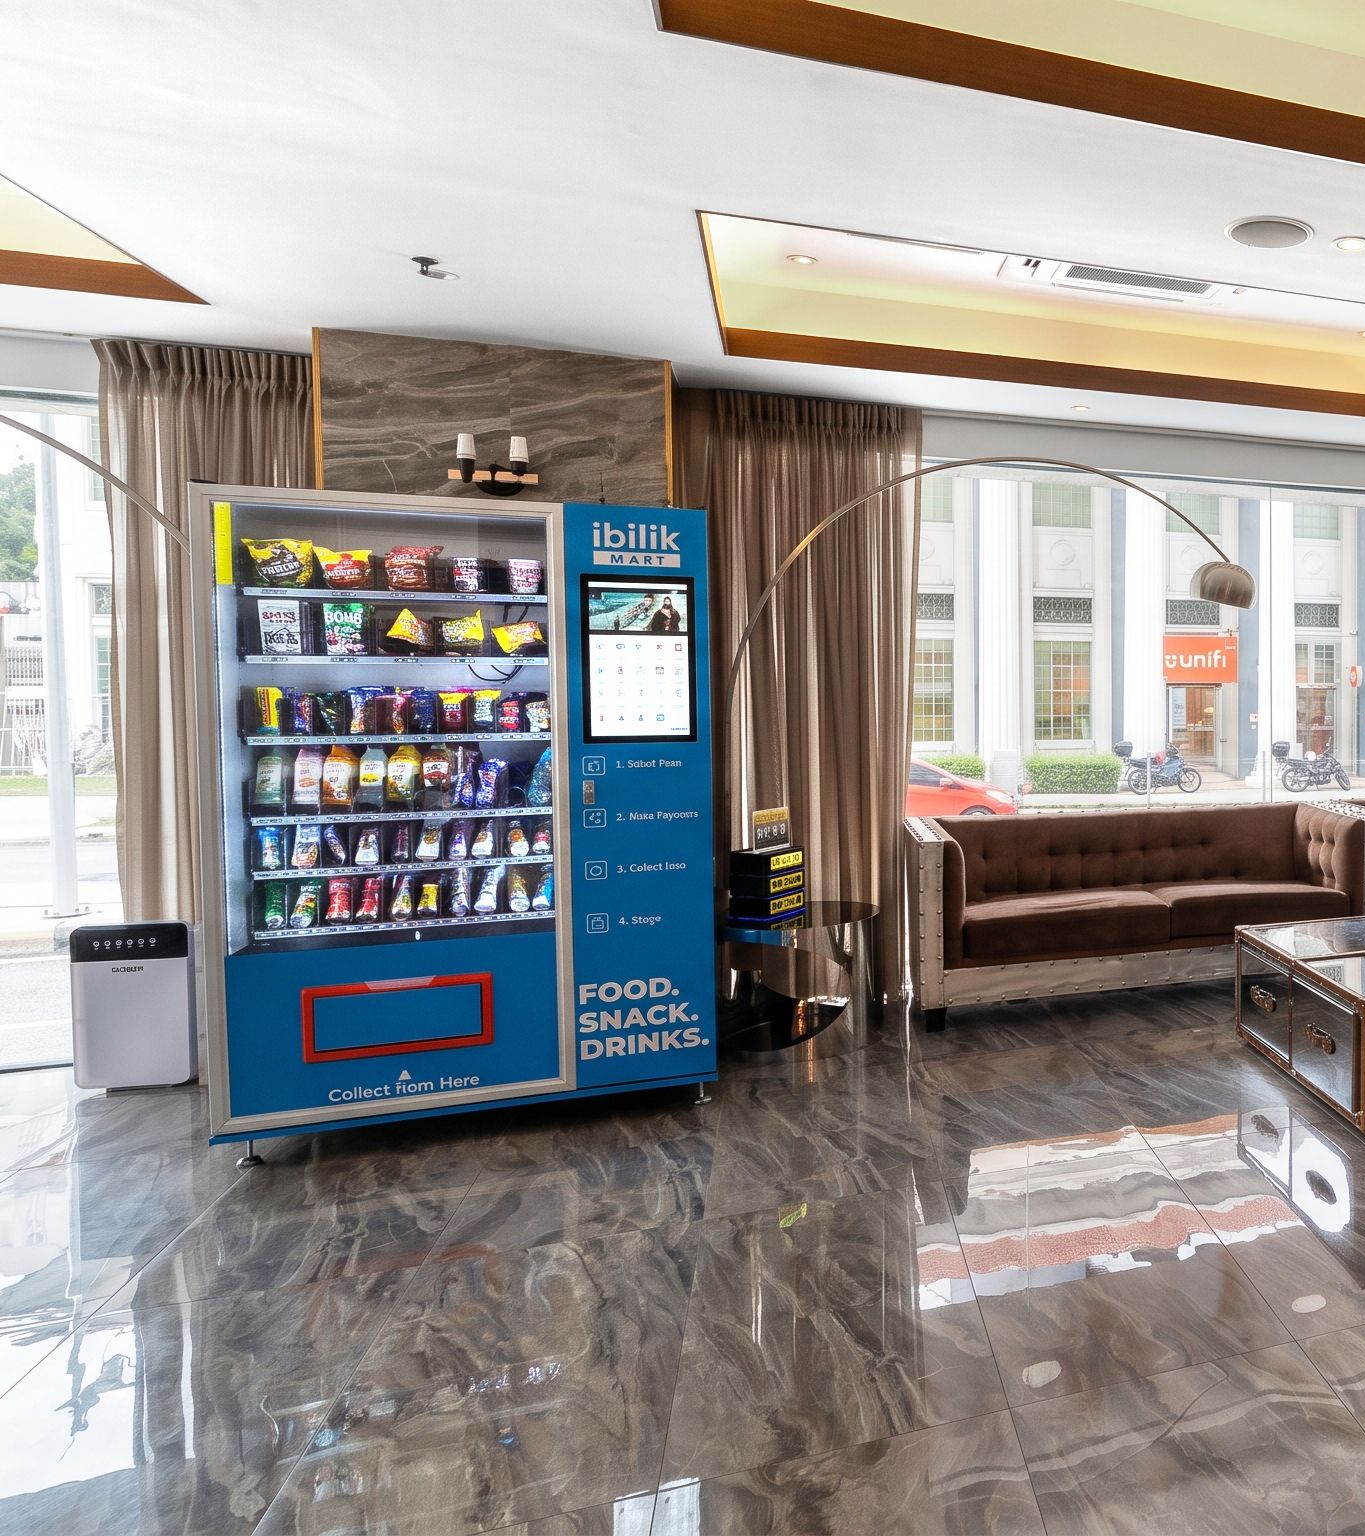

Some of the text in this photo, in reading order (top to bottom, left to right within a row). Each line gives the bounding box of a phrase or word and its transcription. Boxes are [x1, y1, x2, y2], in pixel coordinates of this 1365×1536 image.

[592, 522, 680, 551] ibilik
[610, 554, 665, 565] MART
[1179, 649, 1226, 668] unifi
[615, 760, 625, 769] 1.
[616, 813, 626, 821] 2.
[616, 864, 627, 874] 3.
[618, 916, 629, 925] 4.
[579, 977, 680, 1005] FOOD.
[579, 1002, 699, 1033] SNACK.
[580, 1027, 710, 1061] DRINKS.
[328, 1084, 391, 1102] Collect
[440, 1075, 480, 1089] Here
